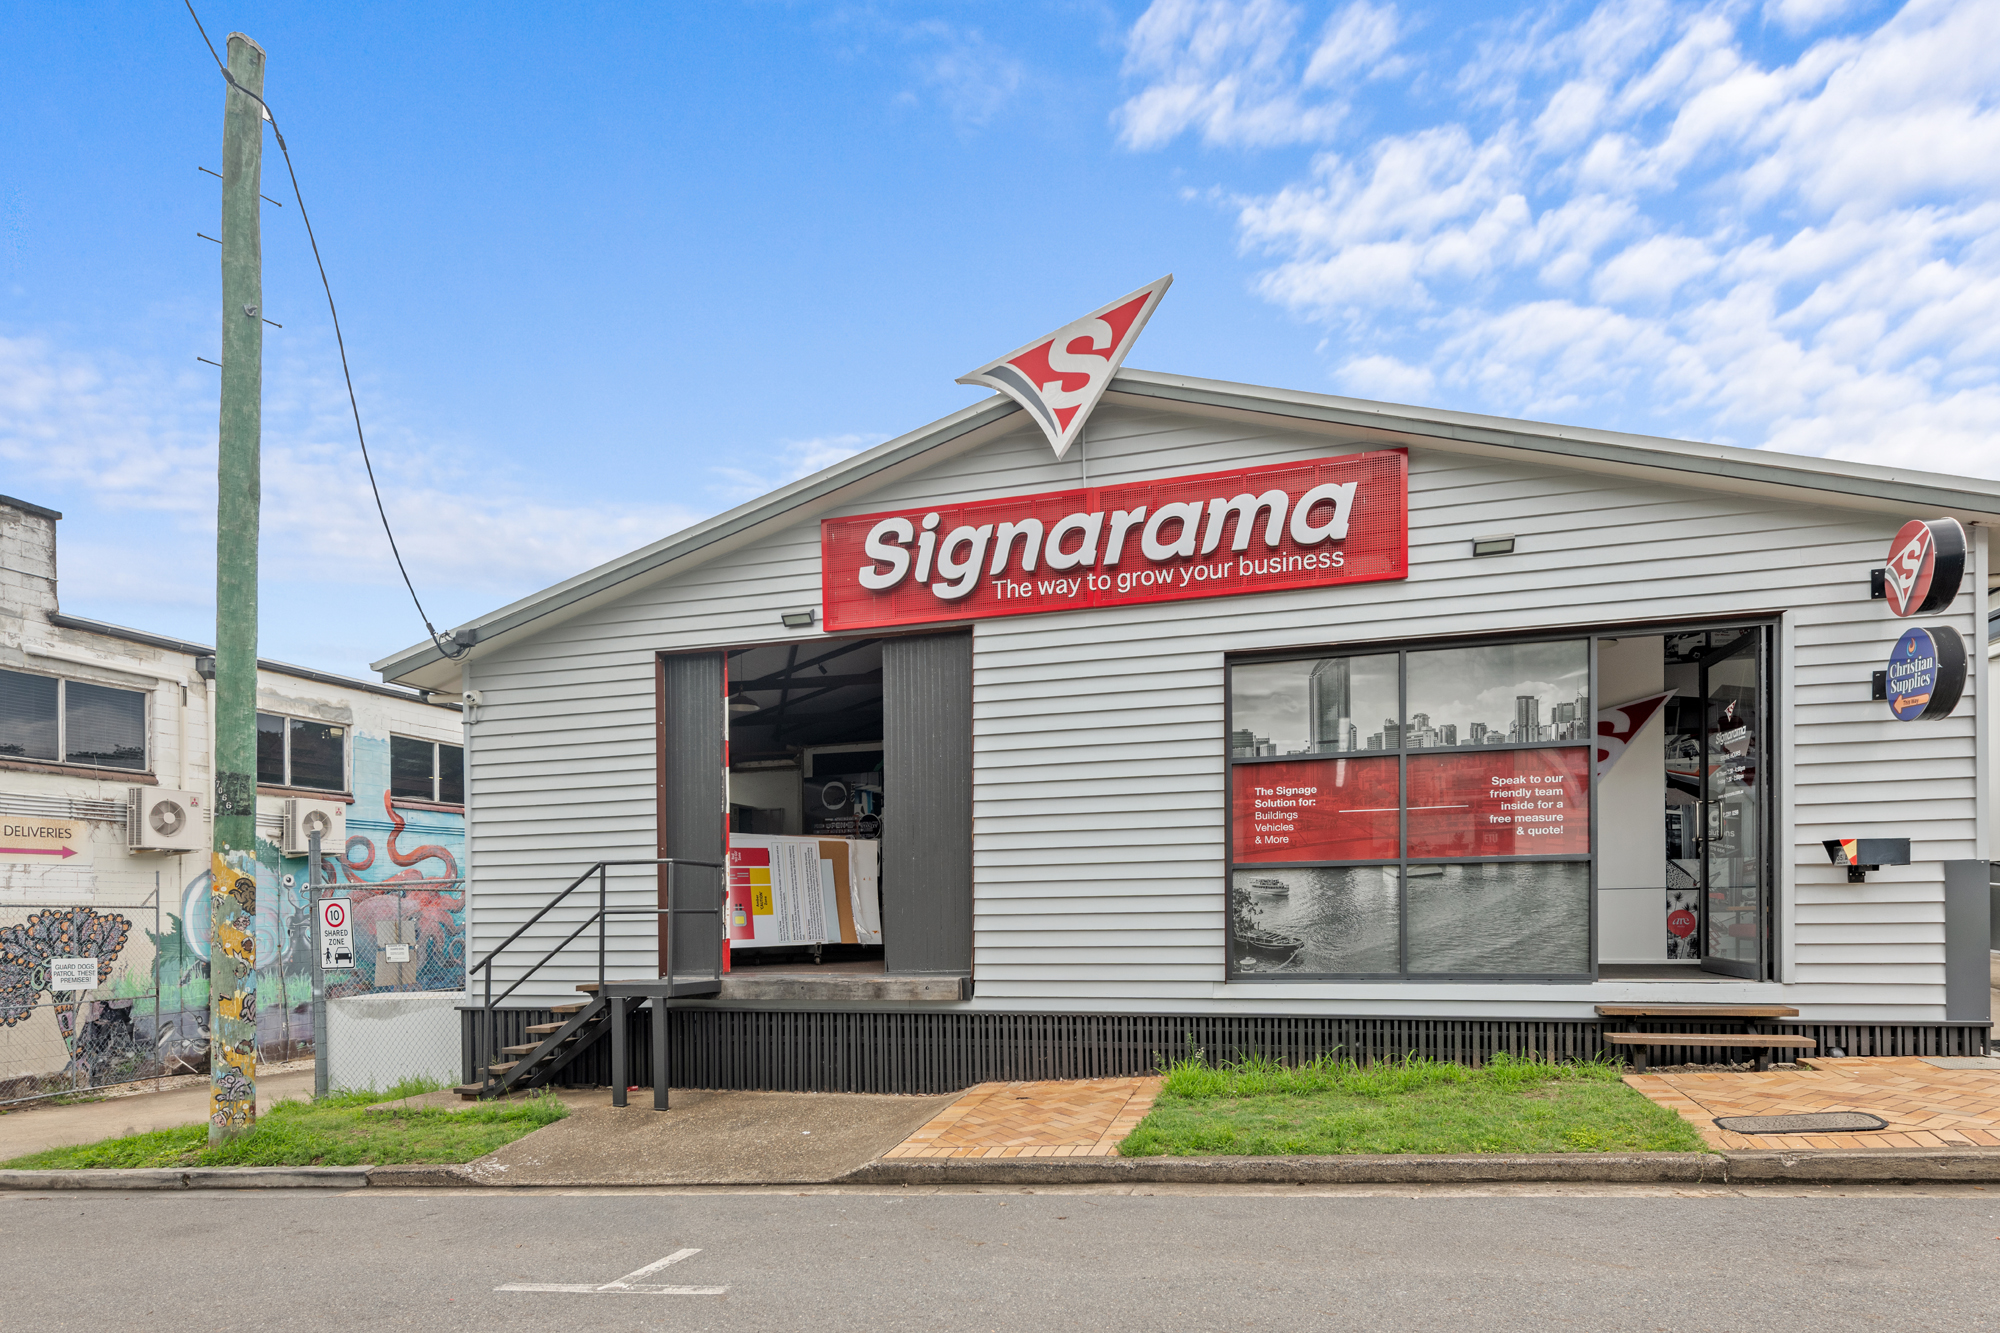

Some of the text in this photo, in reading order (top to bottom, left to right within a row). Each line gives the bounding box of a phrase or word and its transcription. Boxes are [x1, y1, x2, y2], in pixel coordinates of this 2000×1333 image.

[858, 481, 1358, 600] Signarama
[992, 551, 1344, 599] The way to grow your business
[1890, 656, 1933, 678] Christian
[1890, 672, 1931, 694] Supplies
[1491, 775, 1563, 786] Speak to our
[1254, 786, 1317, 796] The Signage
[1489, 788, 1563, 798] friendly team
[1254, 798, 1316, 808] Solution for:
[1501, 801, 1534, 810] inside
[1537, 800, 1554, 809] for
[1254, 811, 1298, 821] Buildings
[1489, 814, 1564, 823] free measure
[3, 825, 72, 839] DELIVERIES
[1254, 823, 1294, 832] Vehicles
[1516, 825, 1564, 836] & quote!
[1254, 835, 1289, 844] & More
[330, 910, 340, 921] 10
[324, 929, 349, 937] SHARED
[328, 938, 345, 946] ZONE
